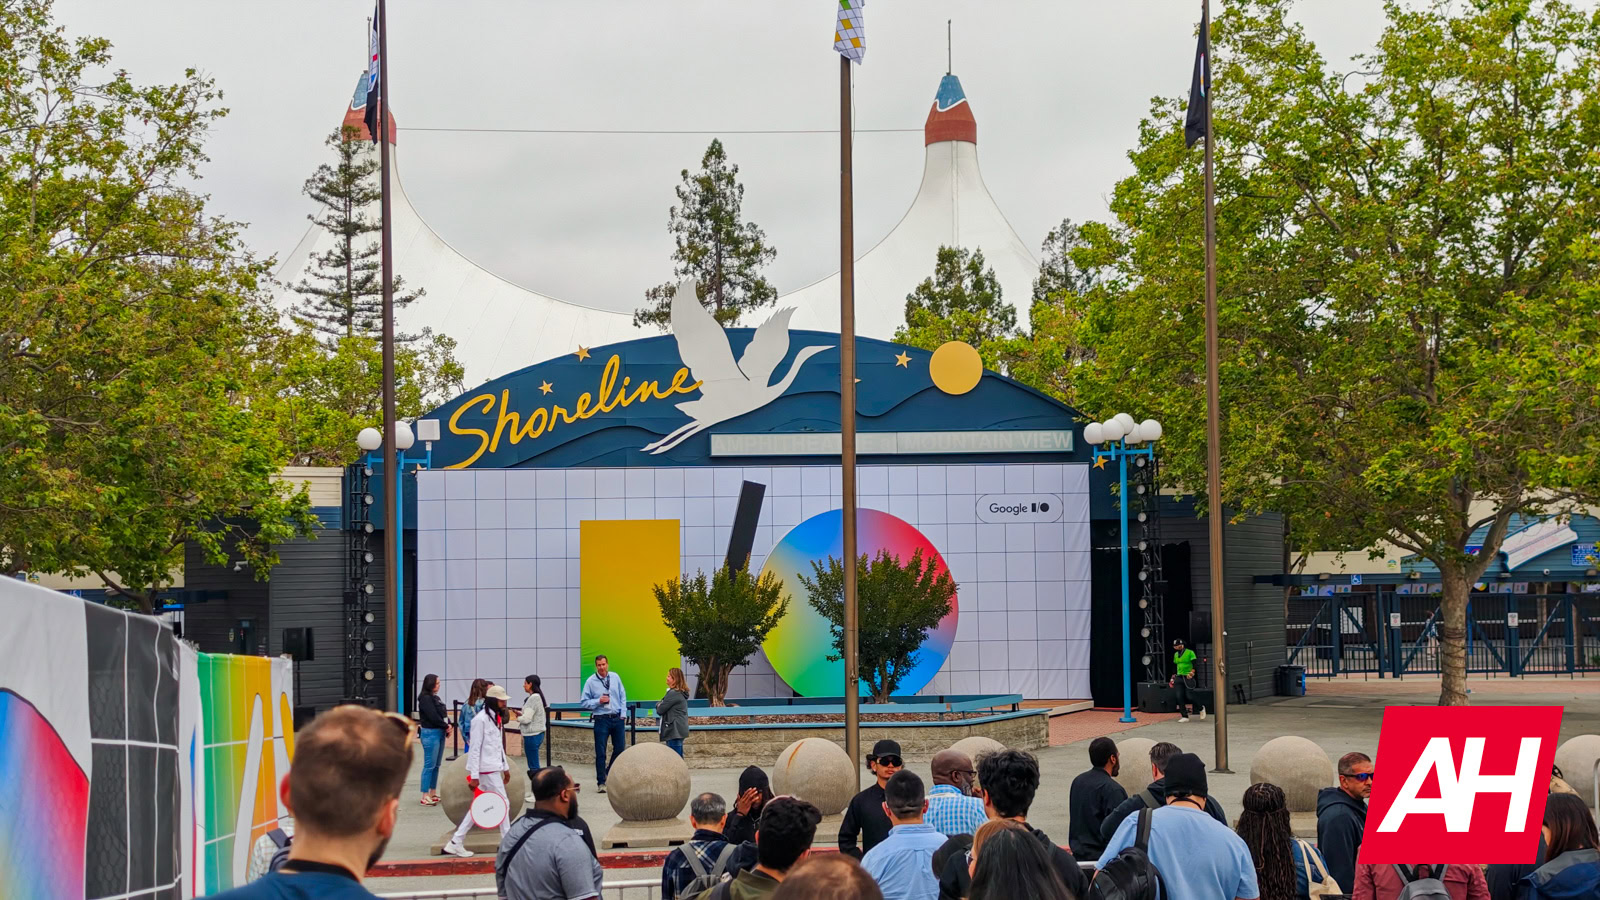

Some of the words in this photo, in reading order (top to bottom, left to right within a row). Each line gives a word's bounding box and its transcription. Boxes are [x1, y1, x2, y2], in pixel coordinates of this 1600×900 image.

[444, 354, 703, 470] Shoreline
[903, 432, 1013, 450] MOUNTAIN
[1019, 431, 1071, 449] VIEW
[989, 502, 1028, 516] Google
